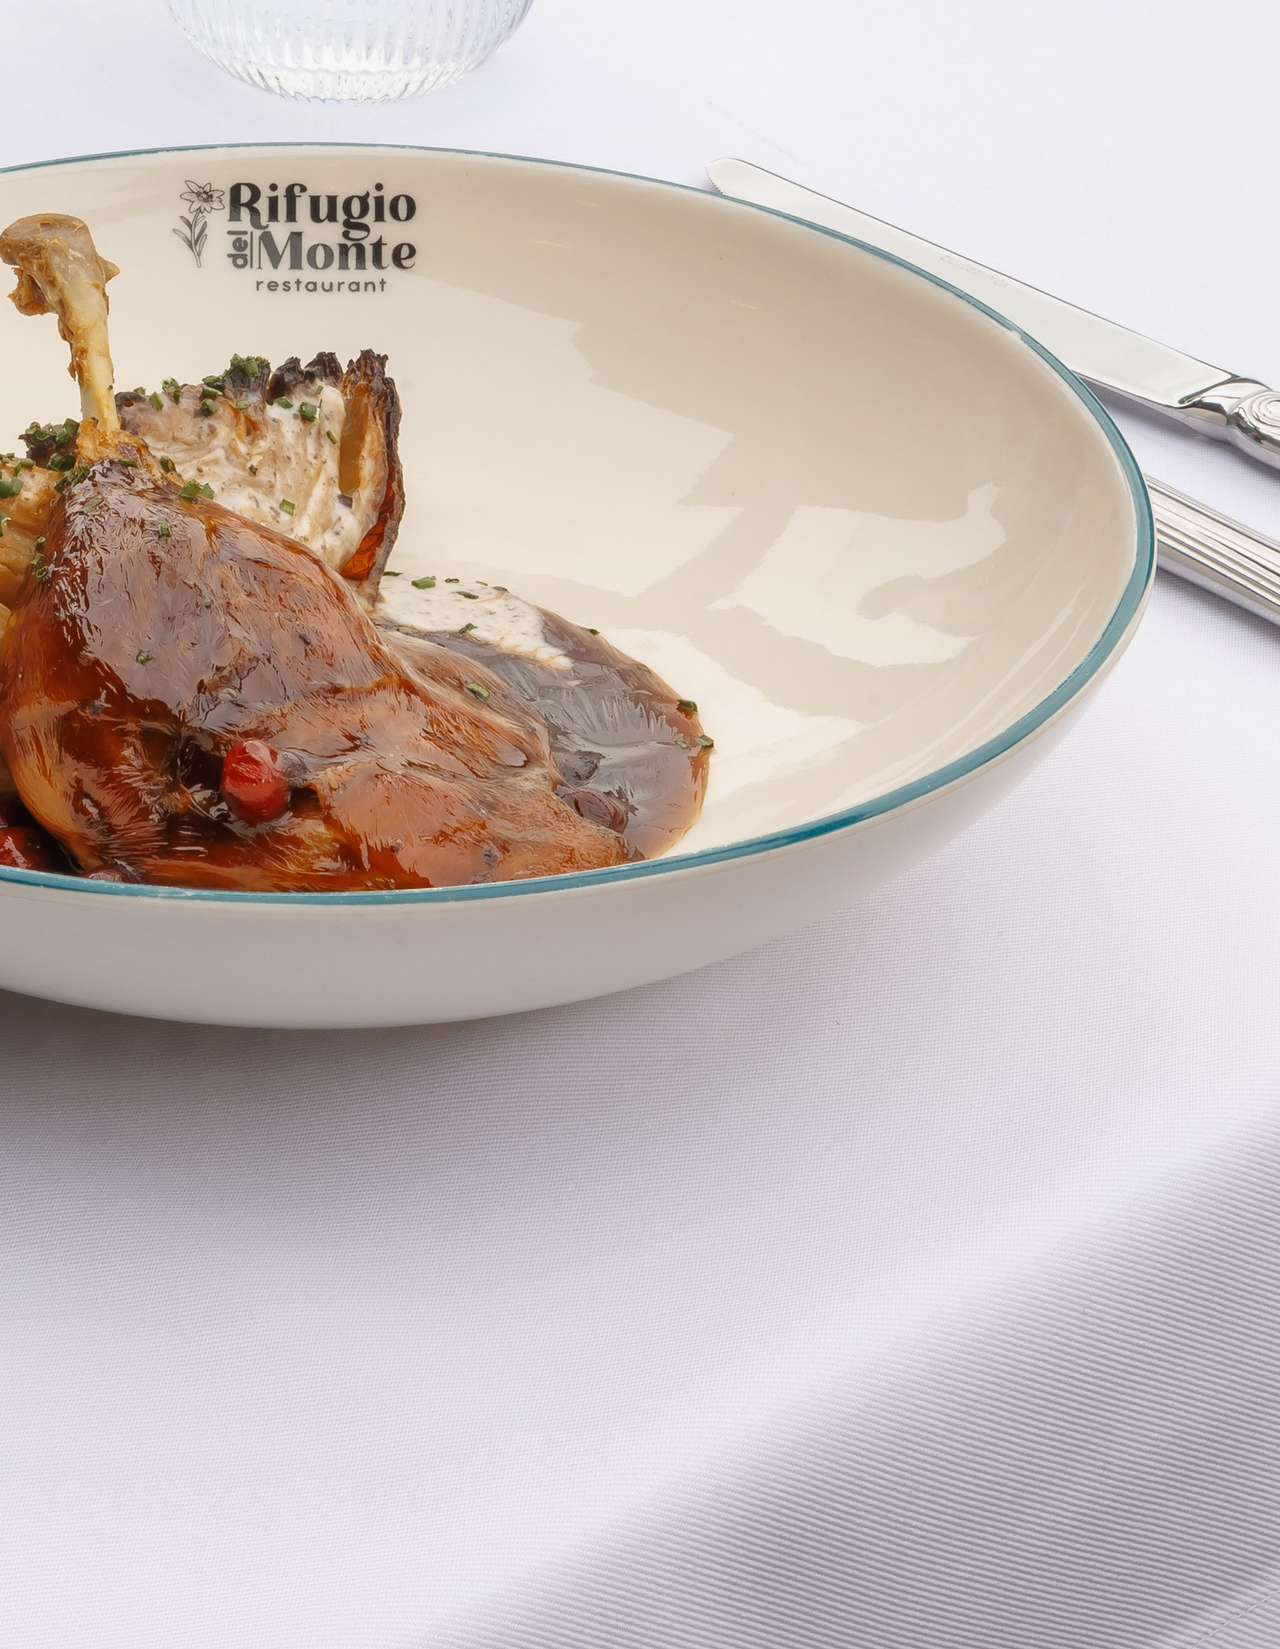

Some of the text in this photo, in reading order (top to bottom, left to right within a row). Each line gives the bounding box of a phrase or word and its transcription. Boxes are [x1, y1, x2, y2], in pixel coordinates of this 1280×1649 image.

[227, 182, 417, 241] Rifugio
[226, 230, 417, 270] del Monte
[256, 278, 387, 292] restaurant
